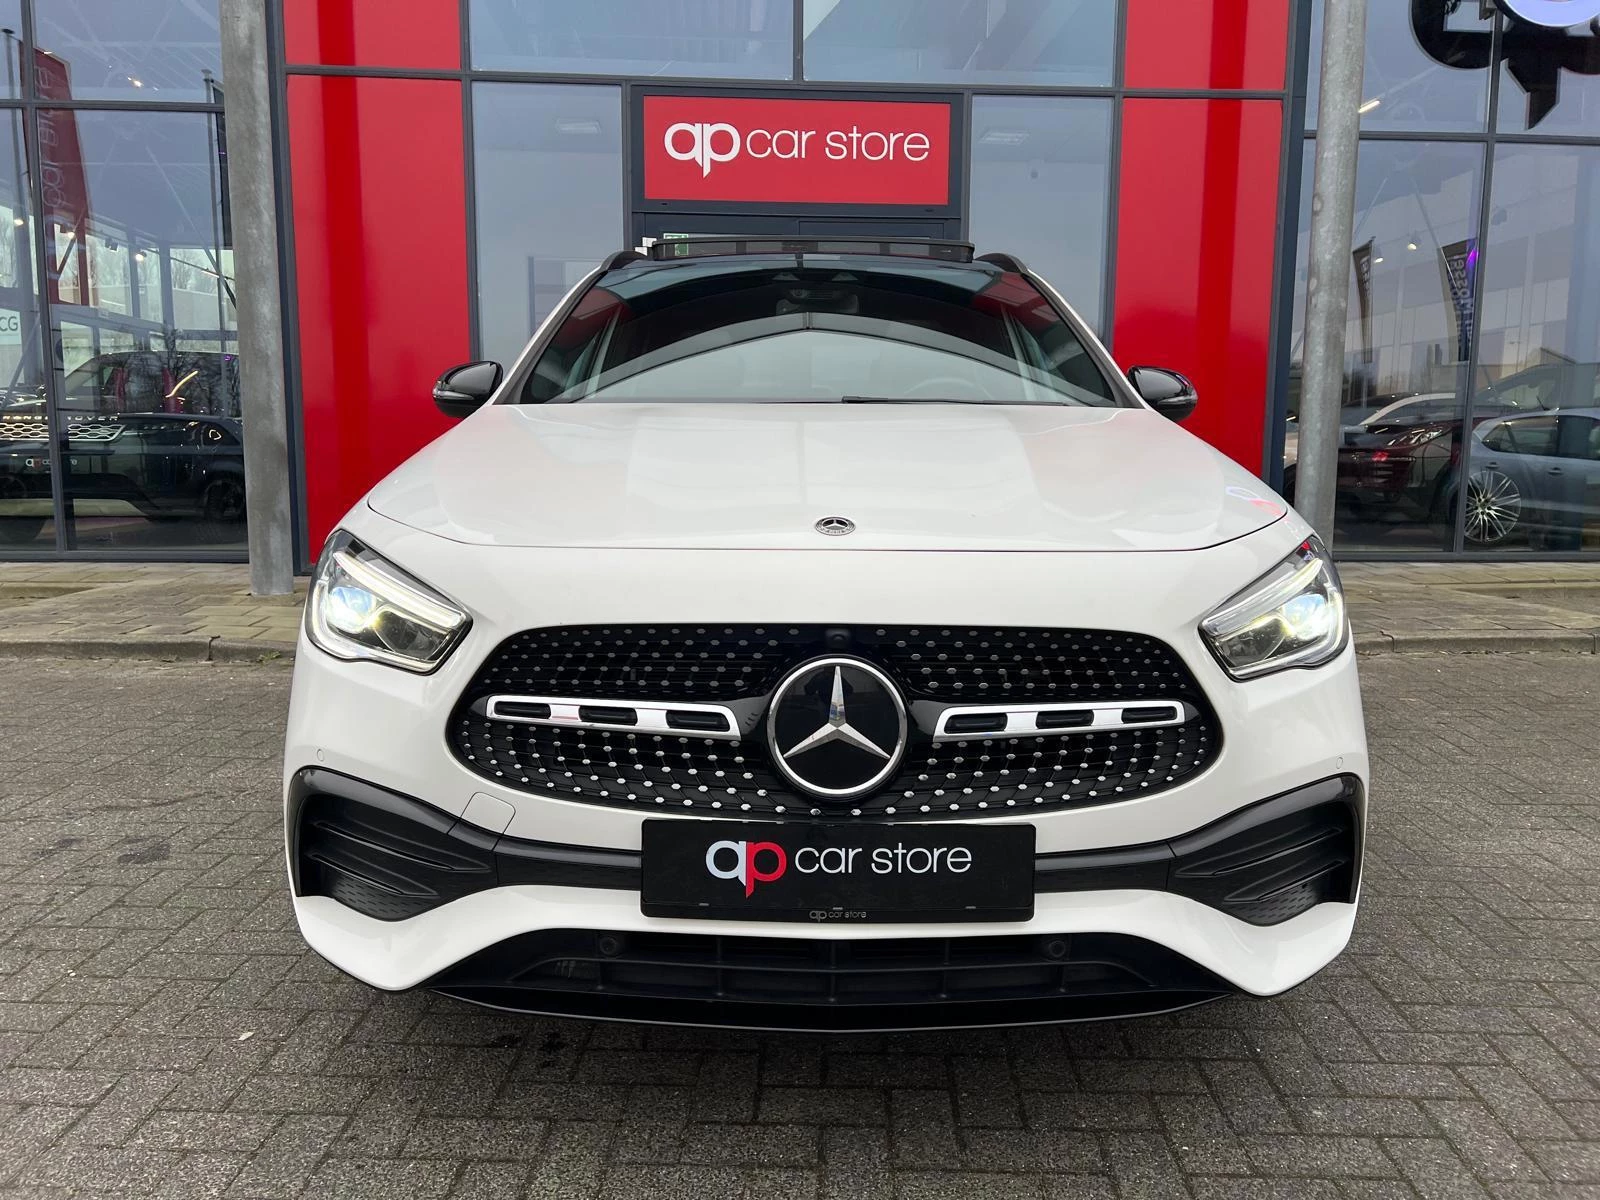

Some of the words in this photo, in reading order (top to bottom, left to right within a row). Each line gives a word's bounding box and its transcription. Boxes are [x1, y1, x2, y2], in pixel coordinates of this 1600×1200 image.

[664, 122, 741, 179] ap
[746, 129, 816, 159] car
[825, 125, 930, 161] store
[705, 840, 787, 899] ap
[795, 847, 863, 874] car
[871, 842, 973, 875] store
[809, 910, 828, 923] ap
[828, 911, 844, 919] car
[844, 910, 867, 919] store
